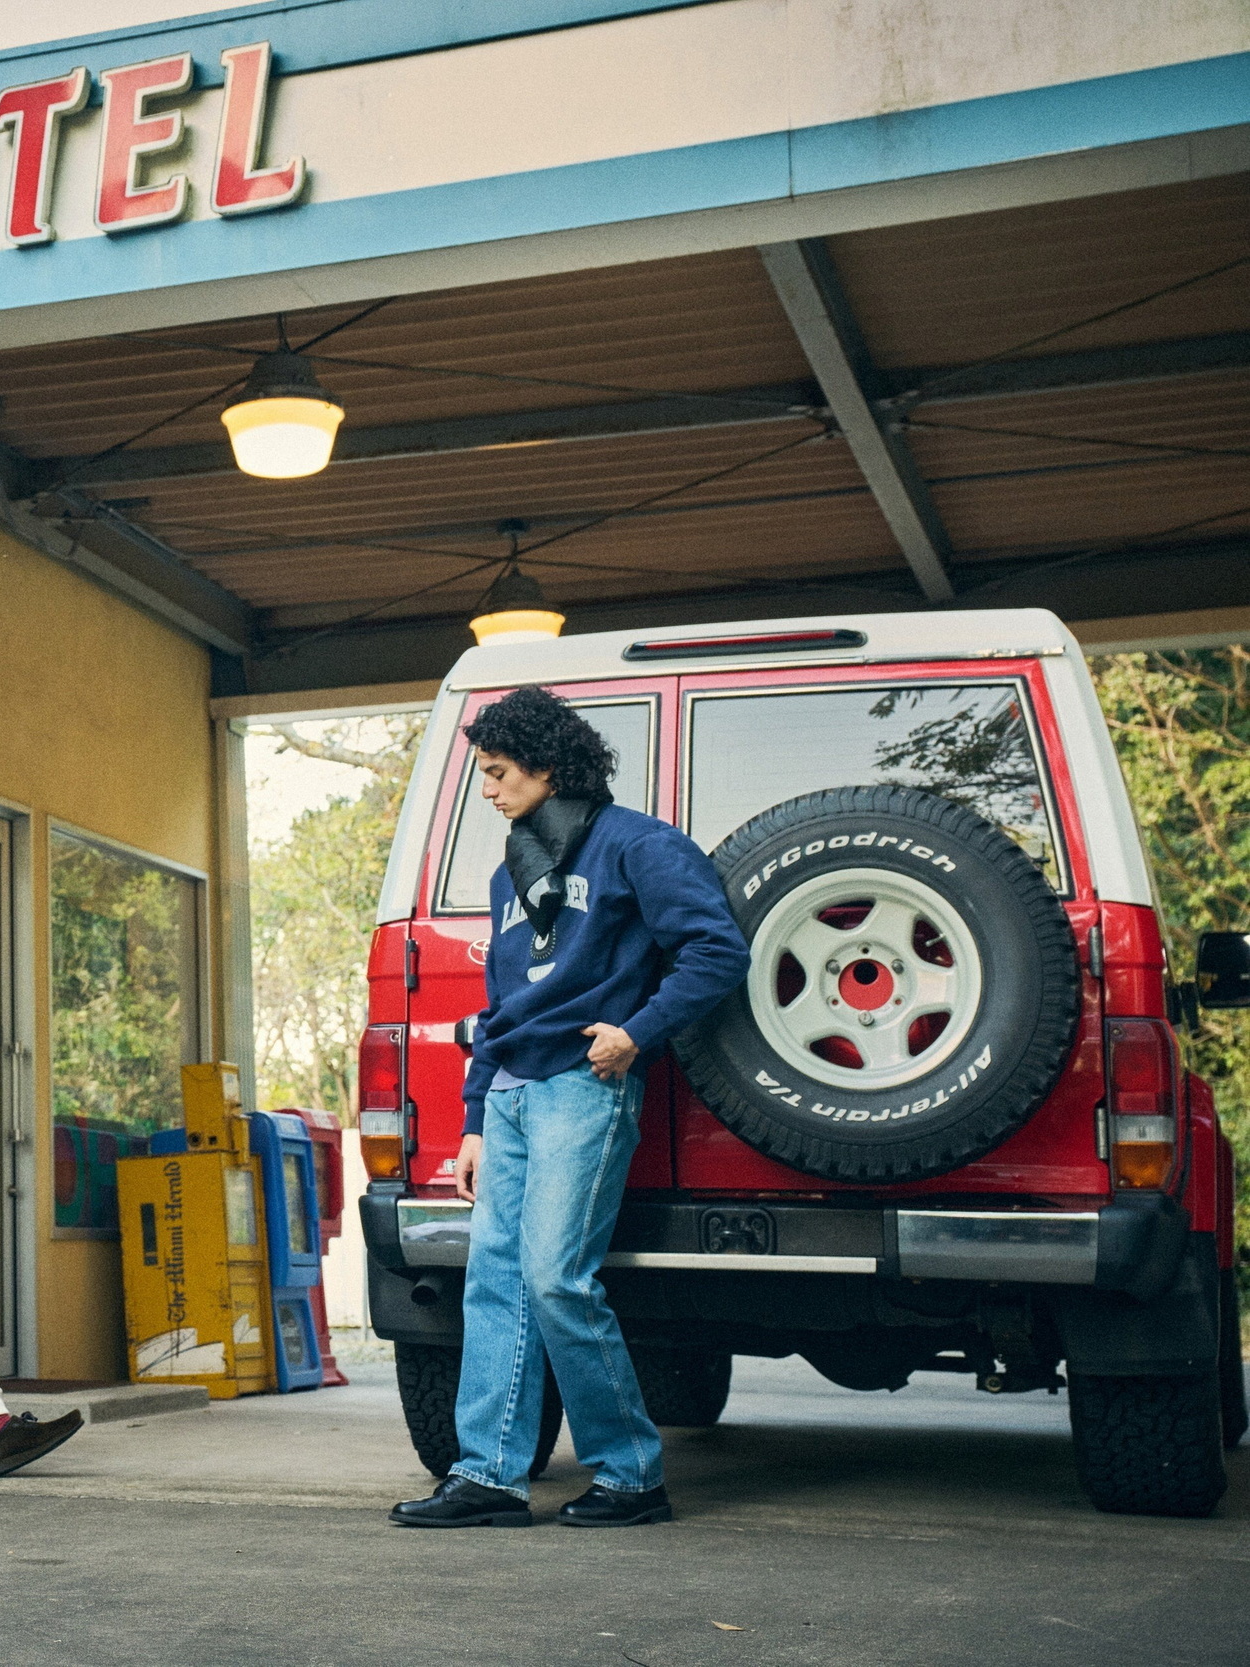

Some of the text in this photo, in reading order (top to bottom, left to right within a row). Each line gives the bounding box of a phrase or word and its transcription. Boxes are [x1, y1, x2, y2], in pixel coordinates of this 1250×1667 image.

[743, 831, 958, 900] BFGoodrich
[755, 1044, 992, 1121] All-Terrain T/A
[164, 1160, 187, 1323] The Miami Herald
